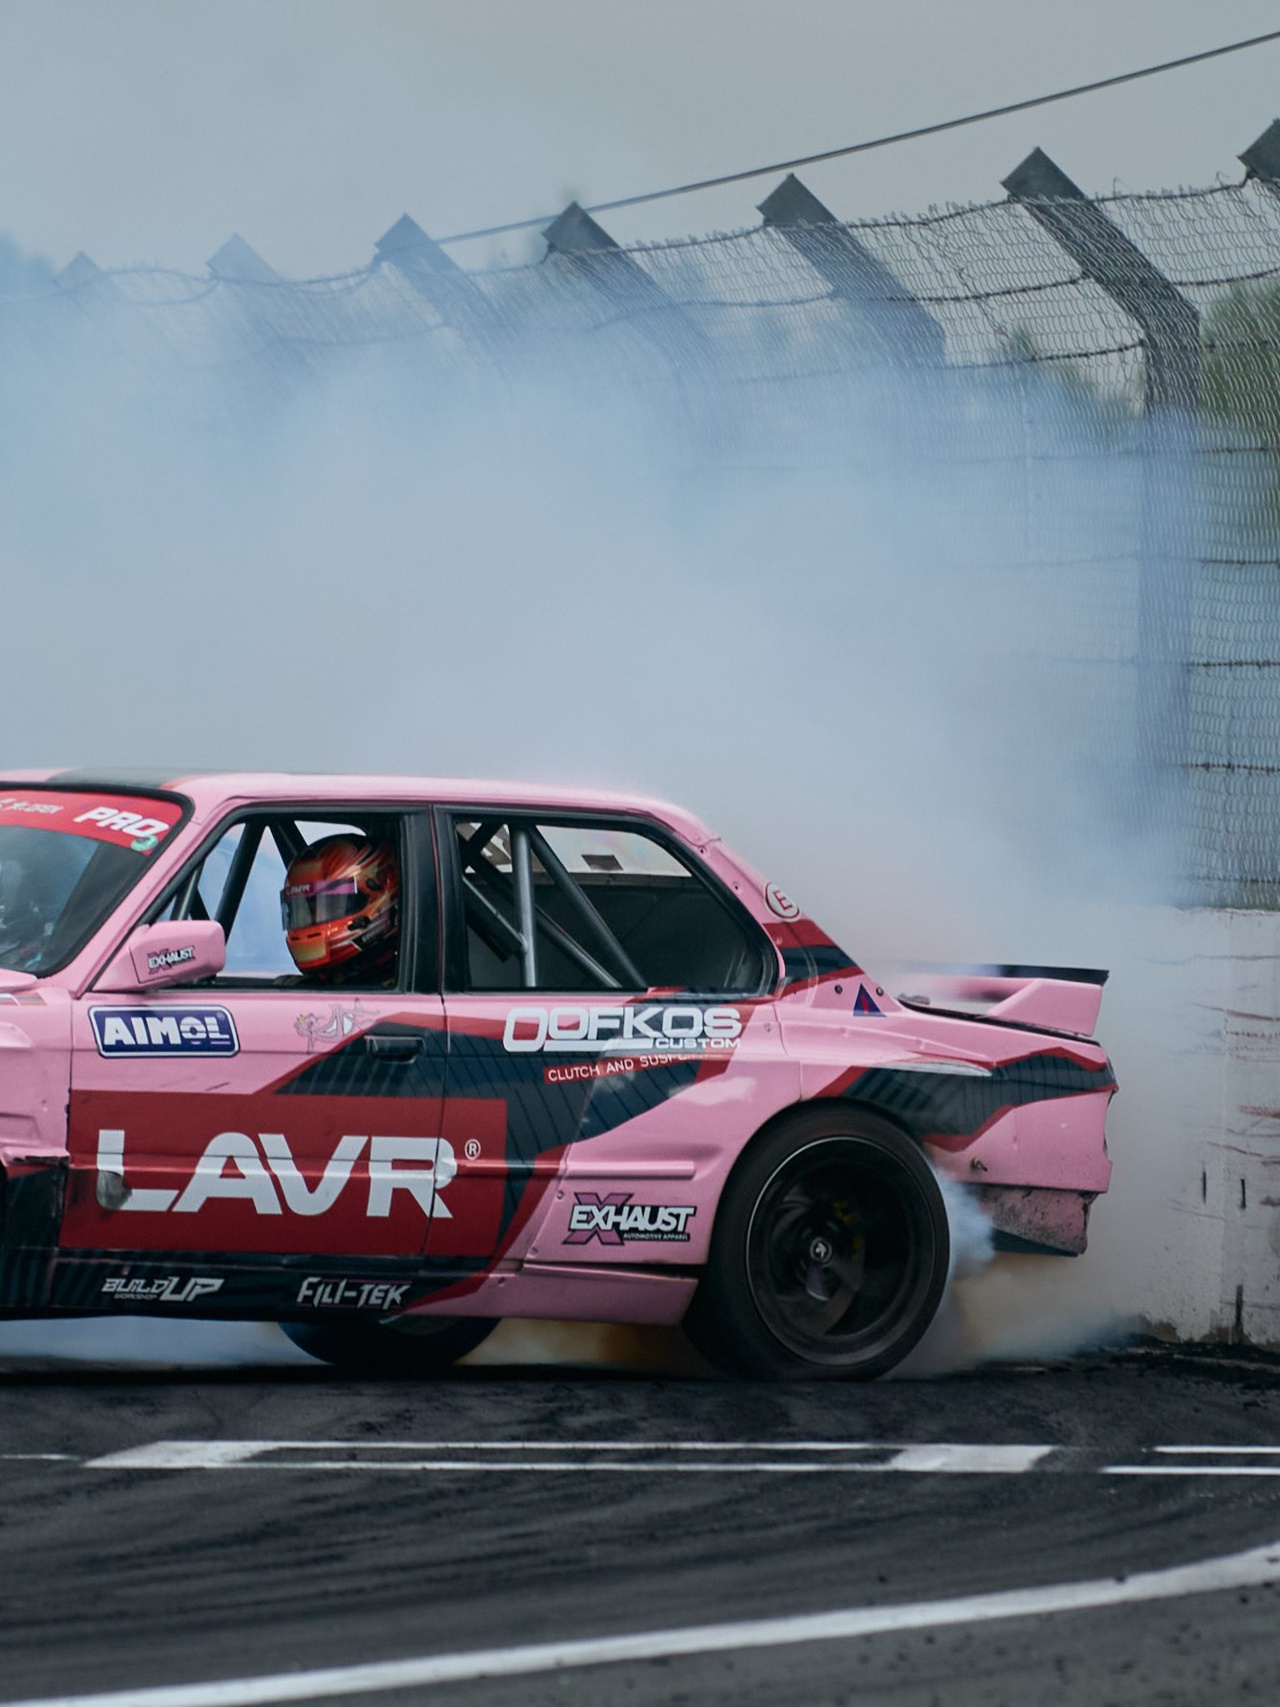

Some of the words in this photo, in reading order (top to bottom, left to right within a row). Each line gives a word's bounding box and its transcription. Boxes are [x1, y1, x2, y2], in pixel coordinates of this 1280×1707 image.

[73, 806, 170, 838] PRO
[148, 946, 195, 969] EXHAUST
[103, 1016, 231, 1046] AIMOL
[655, 1038, 741, 1049] CUSTOM
[548, 1065, 601, 1082] CLUTCH
[606, 1058, 634, 1074] AND
[96, 1129, 458, 1218] LAVR
[569, 1203, 695, 1233] EXHAUST
[296, 1276, 411, 1310] FILI-TEK
